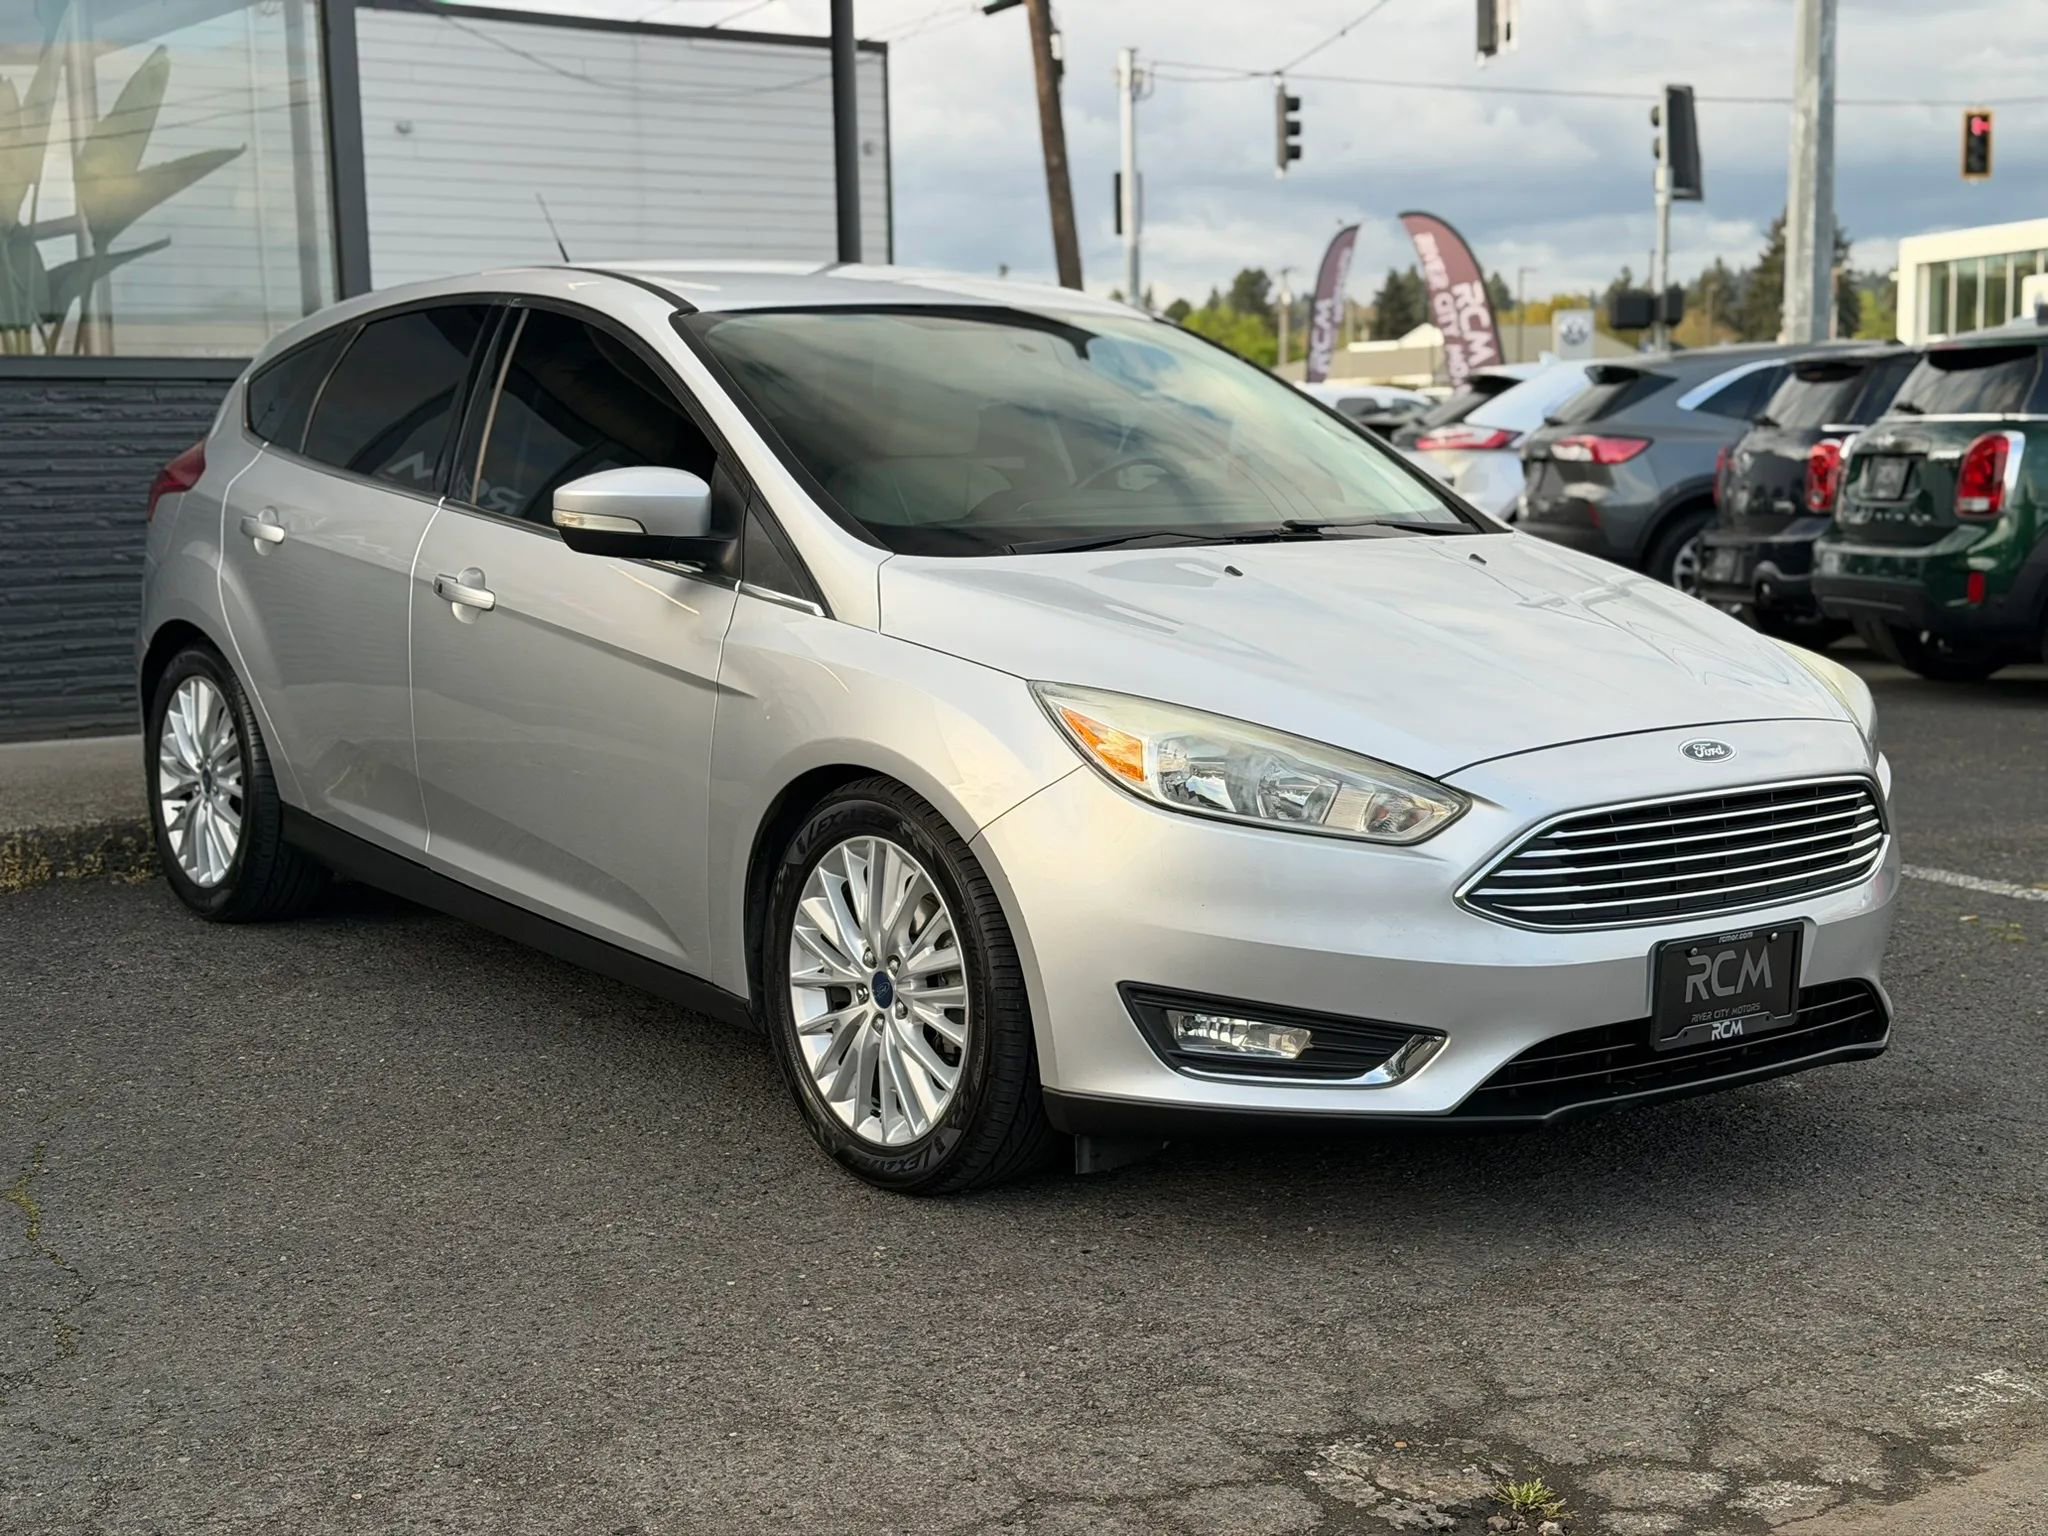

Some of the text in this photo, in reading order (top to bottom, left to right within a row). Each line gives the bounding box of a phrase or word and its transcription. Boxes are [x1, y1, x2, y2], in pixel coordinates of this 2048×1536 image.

[1433, 291, 1461, 337] CITY
[1452, 279, 1496, 368] RCM
[1692, 742, 1725, 758] Ford
[1685, 945, 1773, 1003] RCM
[1691, 1002, 1761, 1023] RIVER CITY MOTORS
[1711, 1019, 1744, 1041] RCM
